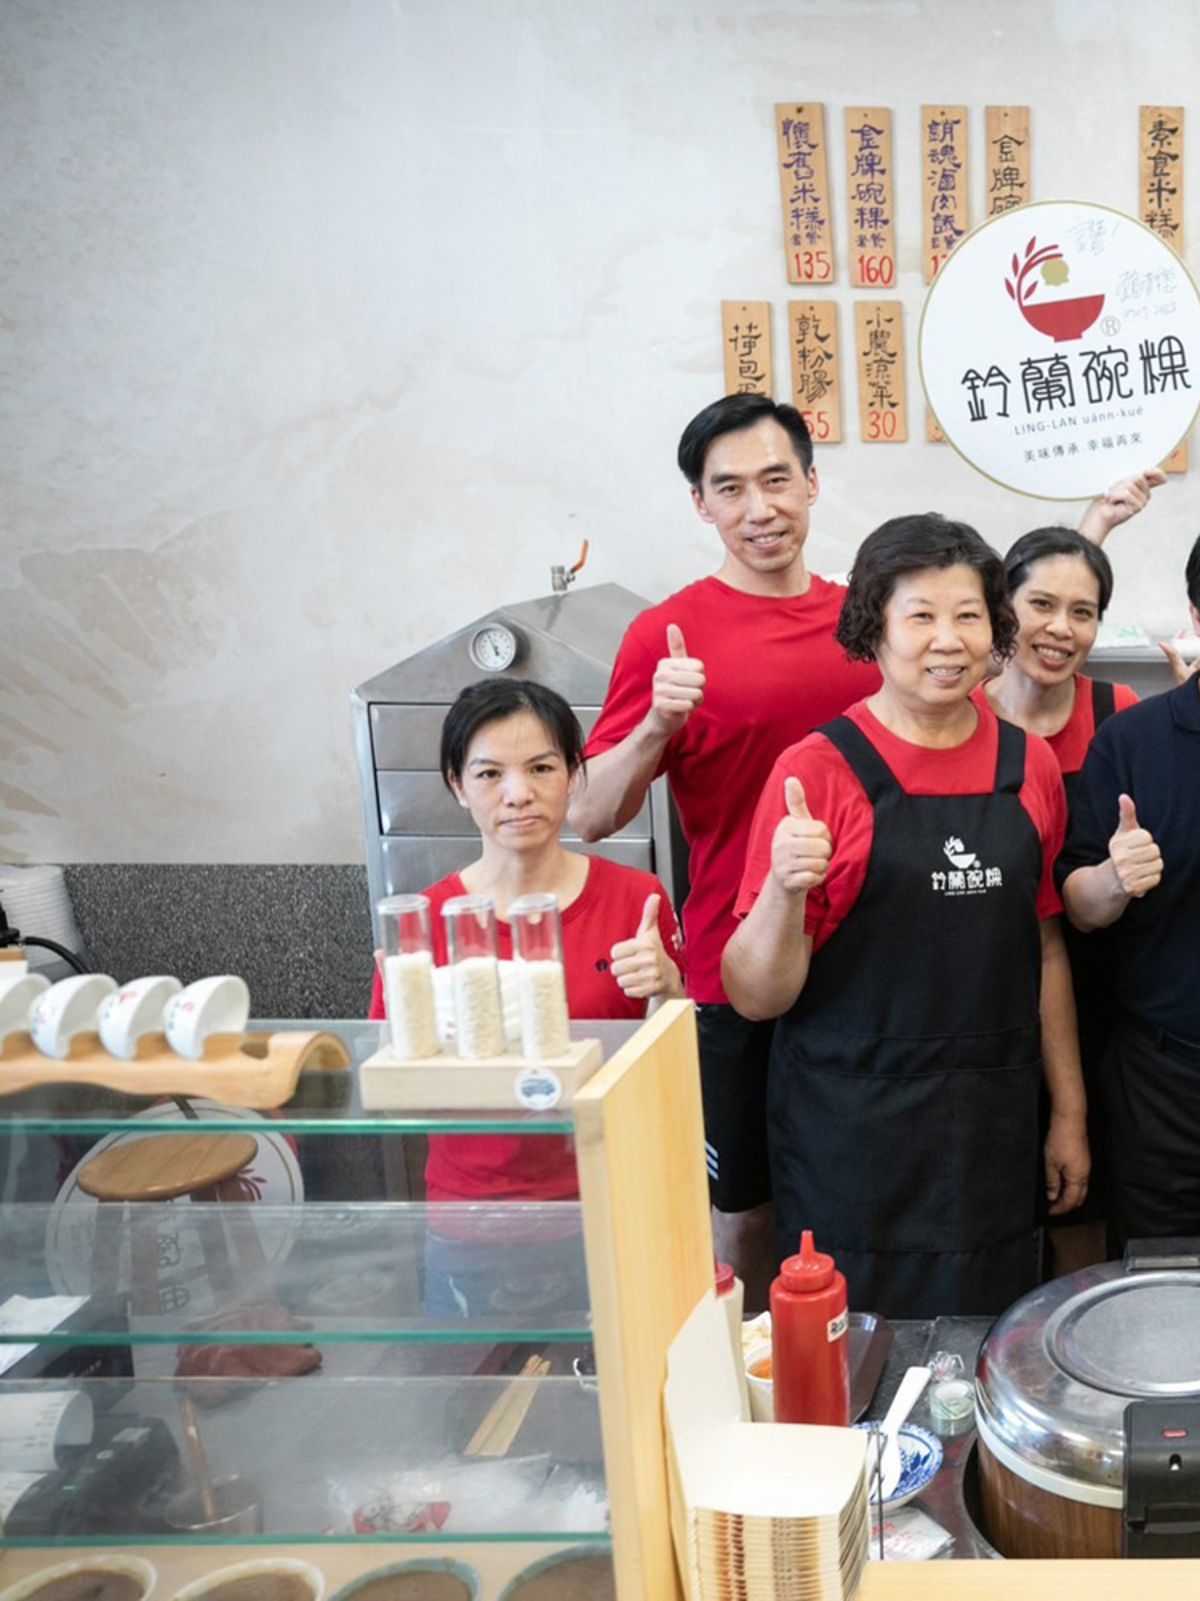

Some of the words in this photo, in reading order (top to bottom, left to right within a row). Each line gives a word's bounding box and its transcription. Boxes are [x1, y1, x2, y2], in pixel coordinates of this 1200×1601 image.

[850, 123, 890, 231] 金牌碗粿
[795, 251, 830, 279] 135
[858, 254, 894, 284] 160
[795, 313, 833, 404] 乾粉腸
[961, 335, 1192, 422] 鈴蘭碗粿
[868, 410, 897, 439] 30
[1014, 416, 1078, 436] LING-LAN
